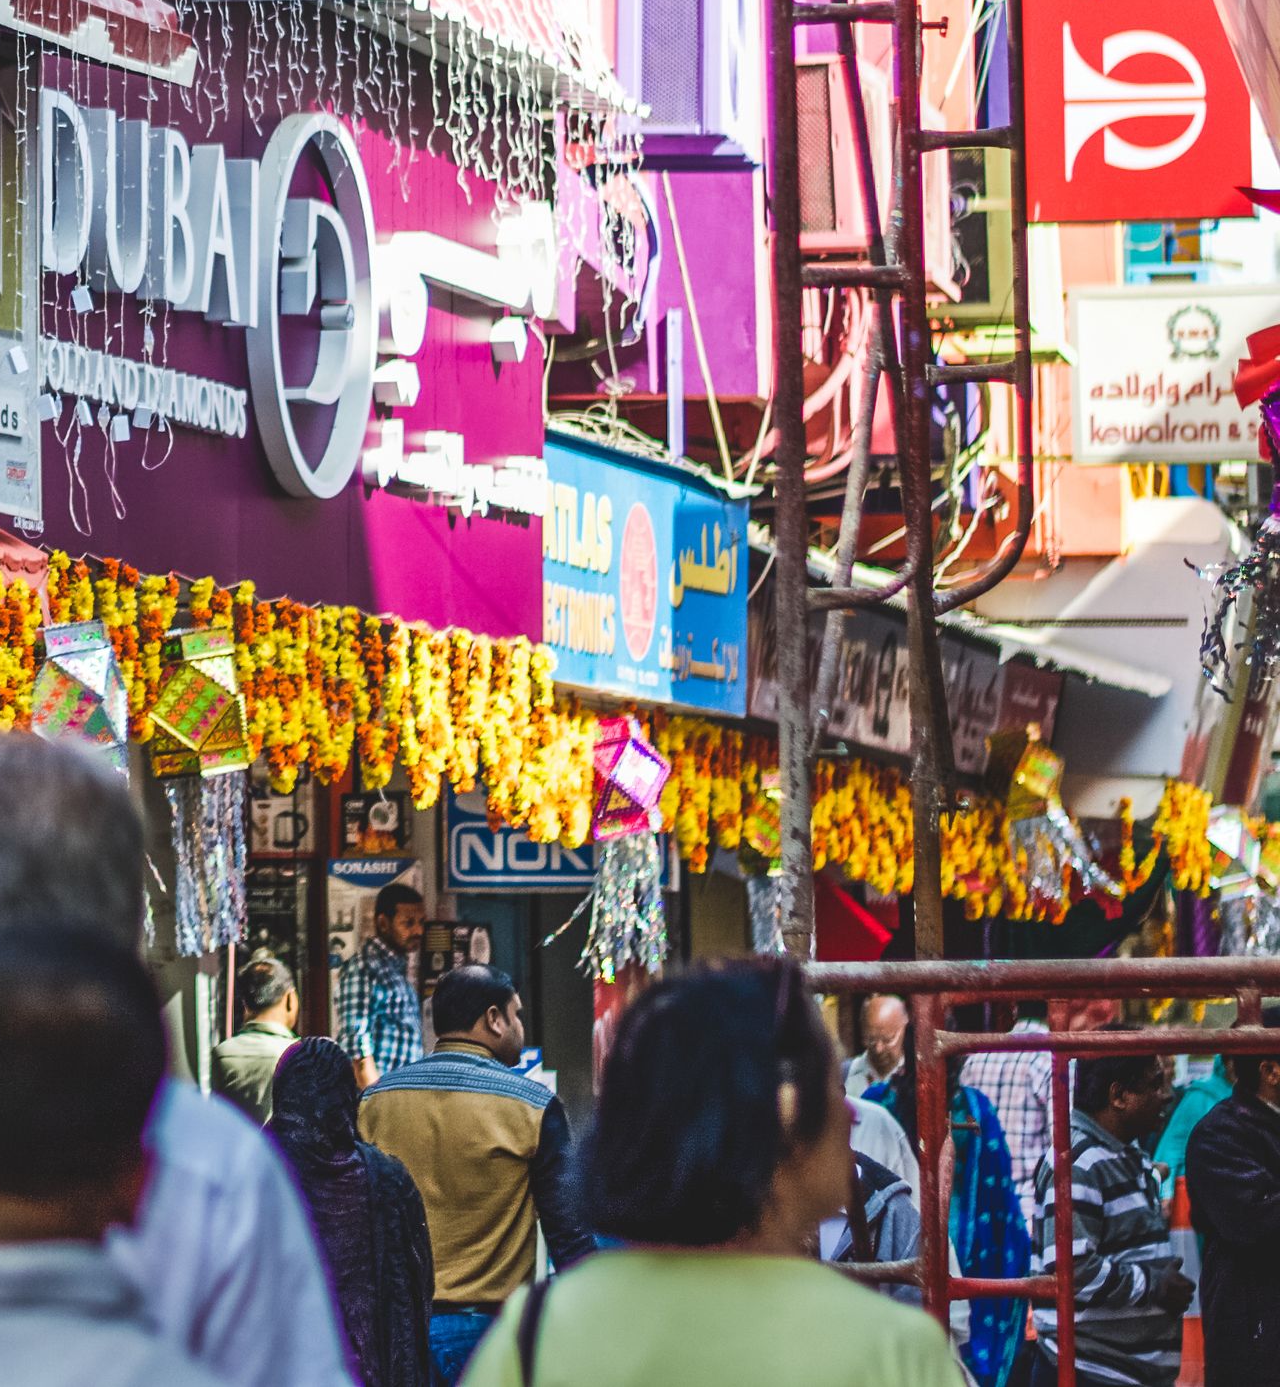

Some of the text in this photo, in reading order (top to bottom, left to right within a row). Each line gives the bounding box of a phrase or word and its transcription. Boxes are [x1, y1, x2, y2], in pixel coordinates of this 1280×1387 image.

[42, 86, 260, 329] DUBAI
[1090, 413, 1221, 445] kewalram
[542, 479, 614, 574] ATLAS
